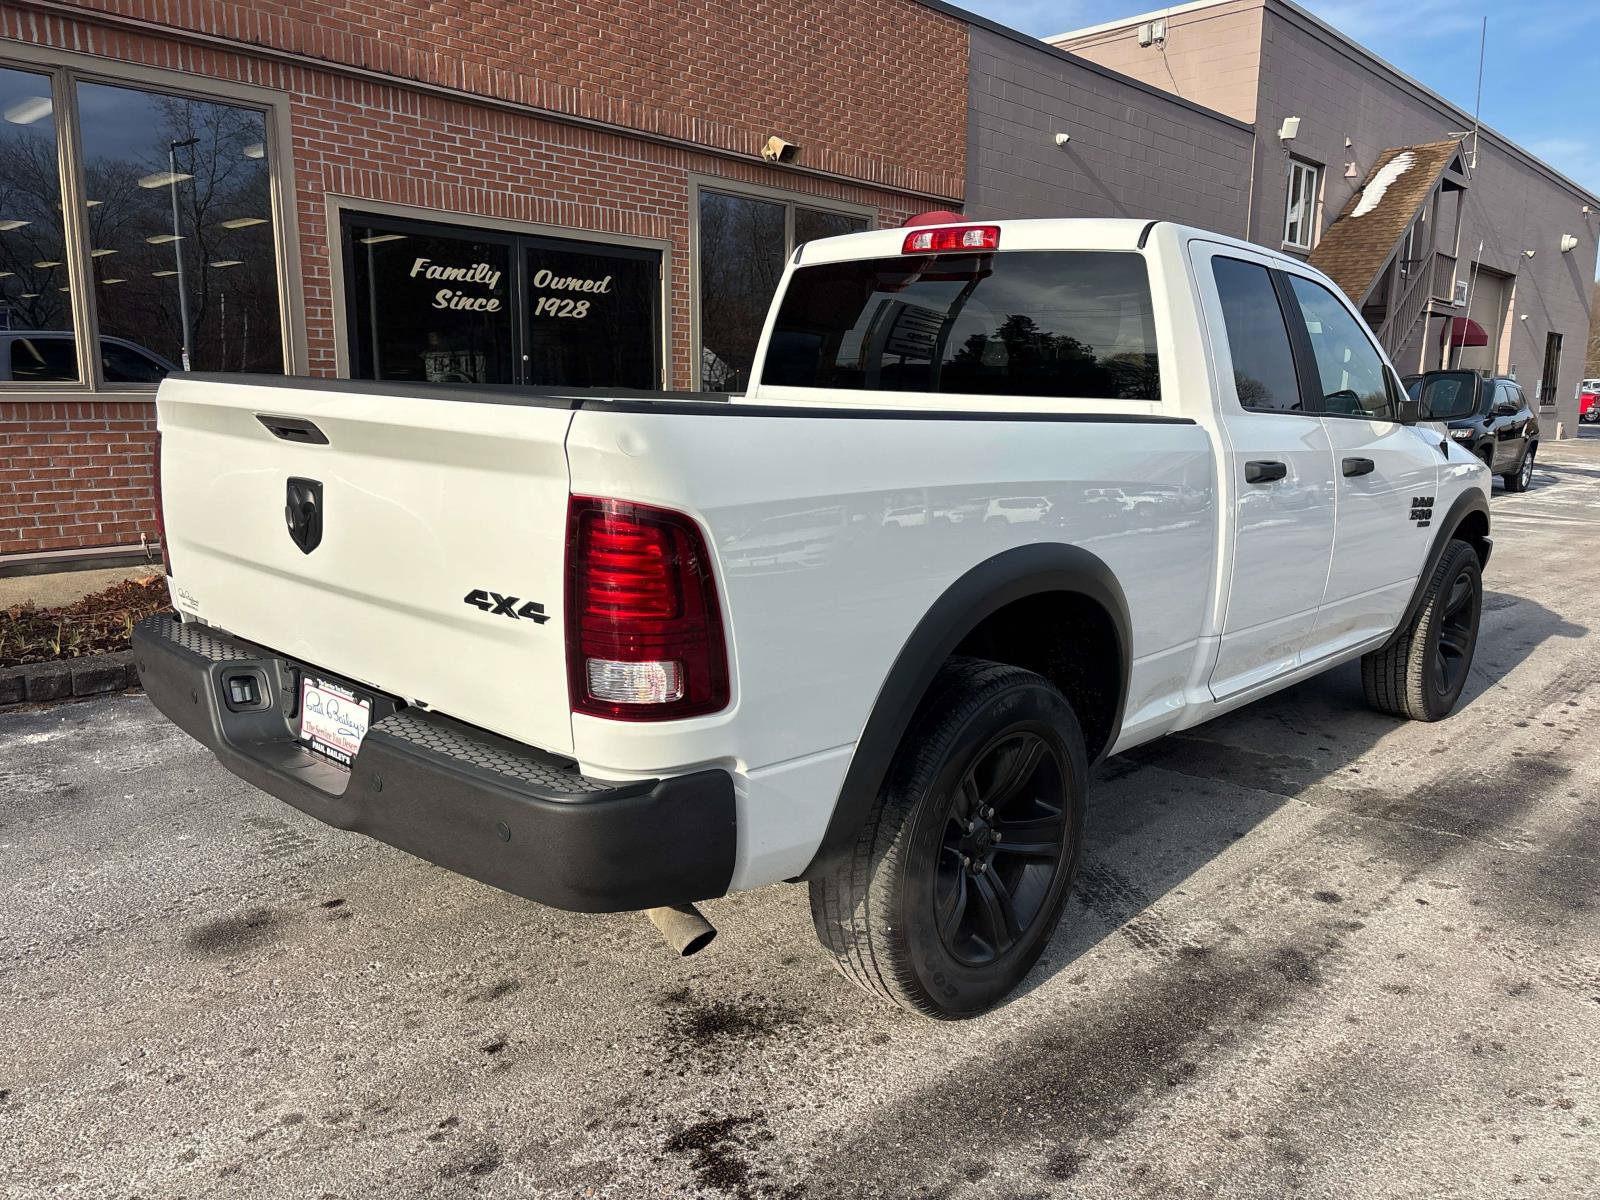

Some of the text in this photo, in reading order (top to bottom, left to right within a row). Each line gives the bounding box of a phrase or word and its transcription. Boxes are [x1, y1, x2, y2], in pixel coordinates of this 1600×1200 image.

[410, 257, 612, 294] Family Owned
[431, 288, 591, 319] Since 1928
[305, 720, 315, 733] The
